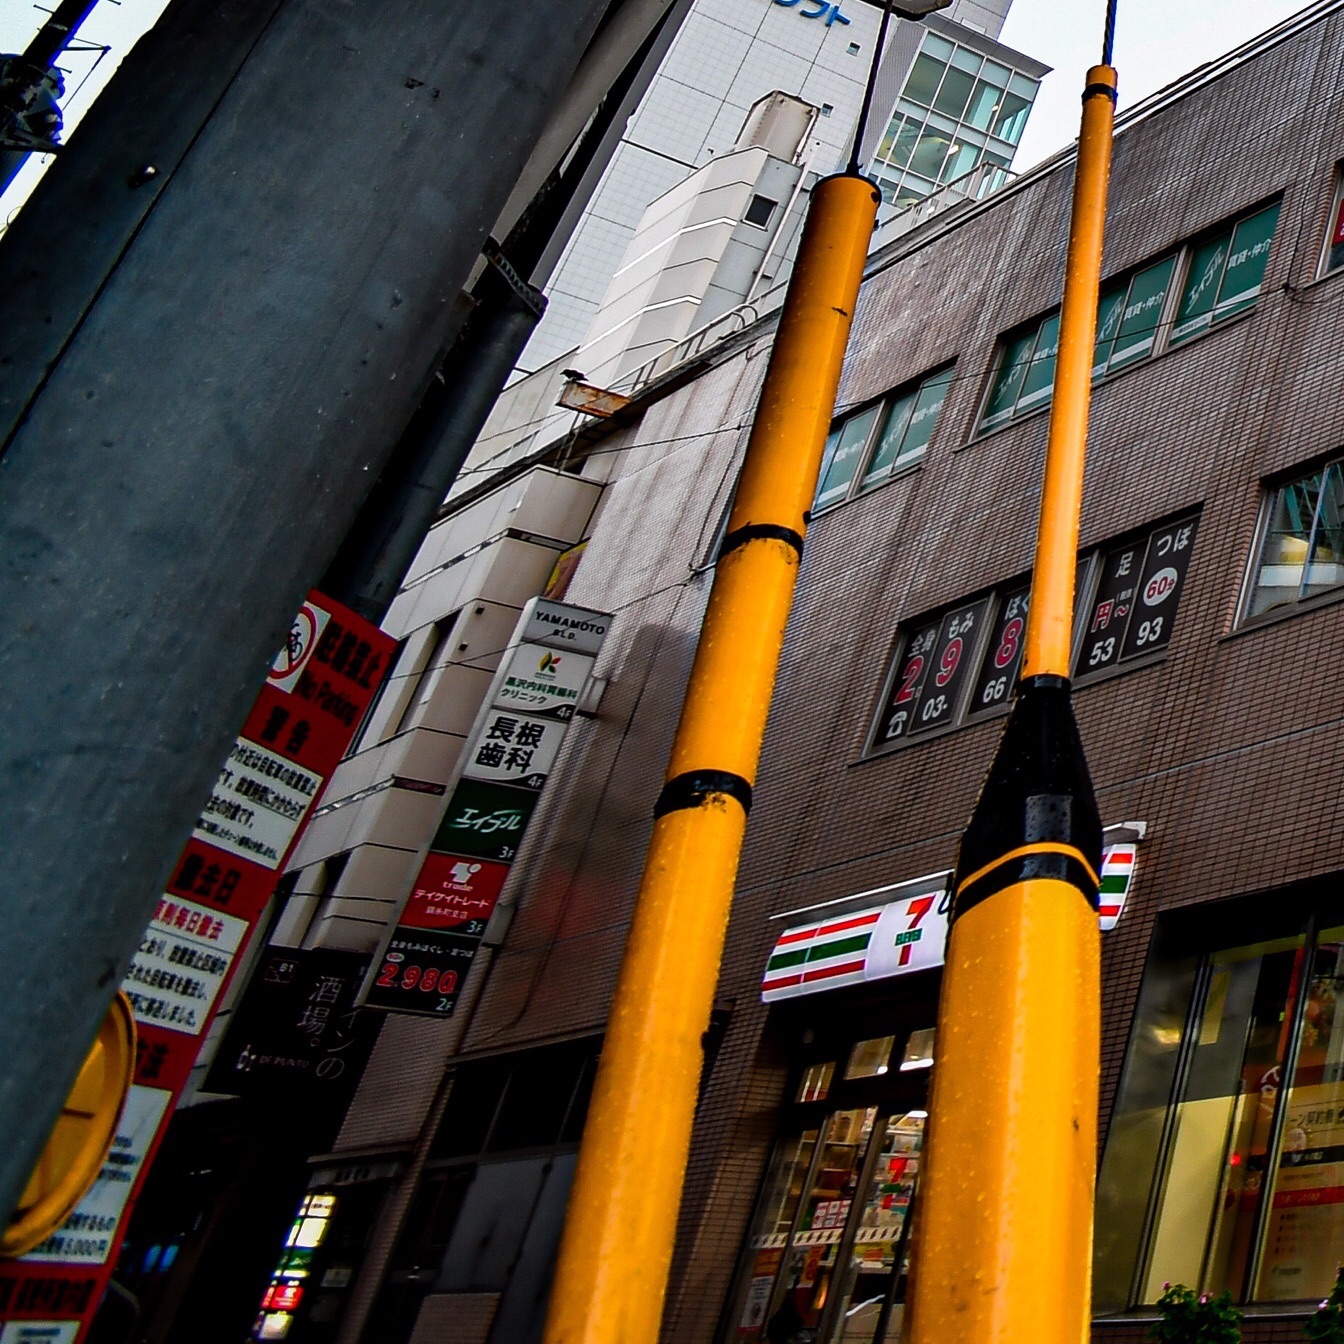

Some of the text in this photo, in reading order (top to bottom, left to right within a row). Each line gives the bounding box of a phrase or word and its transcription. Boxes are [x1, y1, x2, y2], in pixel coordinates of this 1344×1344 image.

[908, 628, 937, 657] 全身
[1115, 550, 1135, 579] 足
[534, 610, 606, 636] YAMAMOTO
[500, 687, 548, 706] クリニック
[556, 706, 573, 719] 4F
[486, 715, 546, 750] 長根
[475, 742, 535, 775] 歯科
[527, 775, 543, 788] 4F
[450, 807, 524, 833] エイブル
[498, 845, 515, 859] 3F
[413, 889, 492, 908] テイケイトレード
[466, 920, 484, 933] 3F
[435, 997, 454, 1012] 2F
